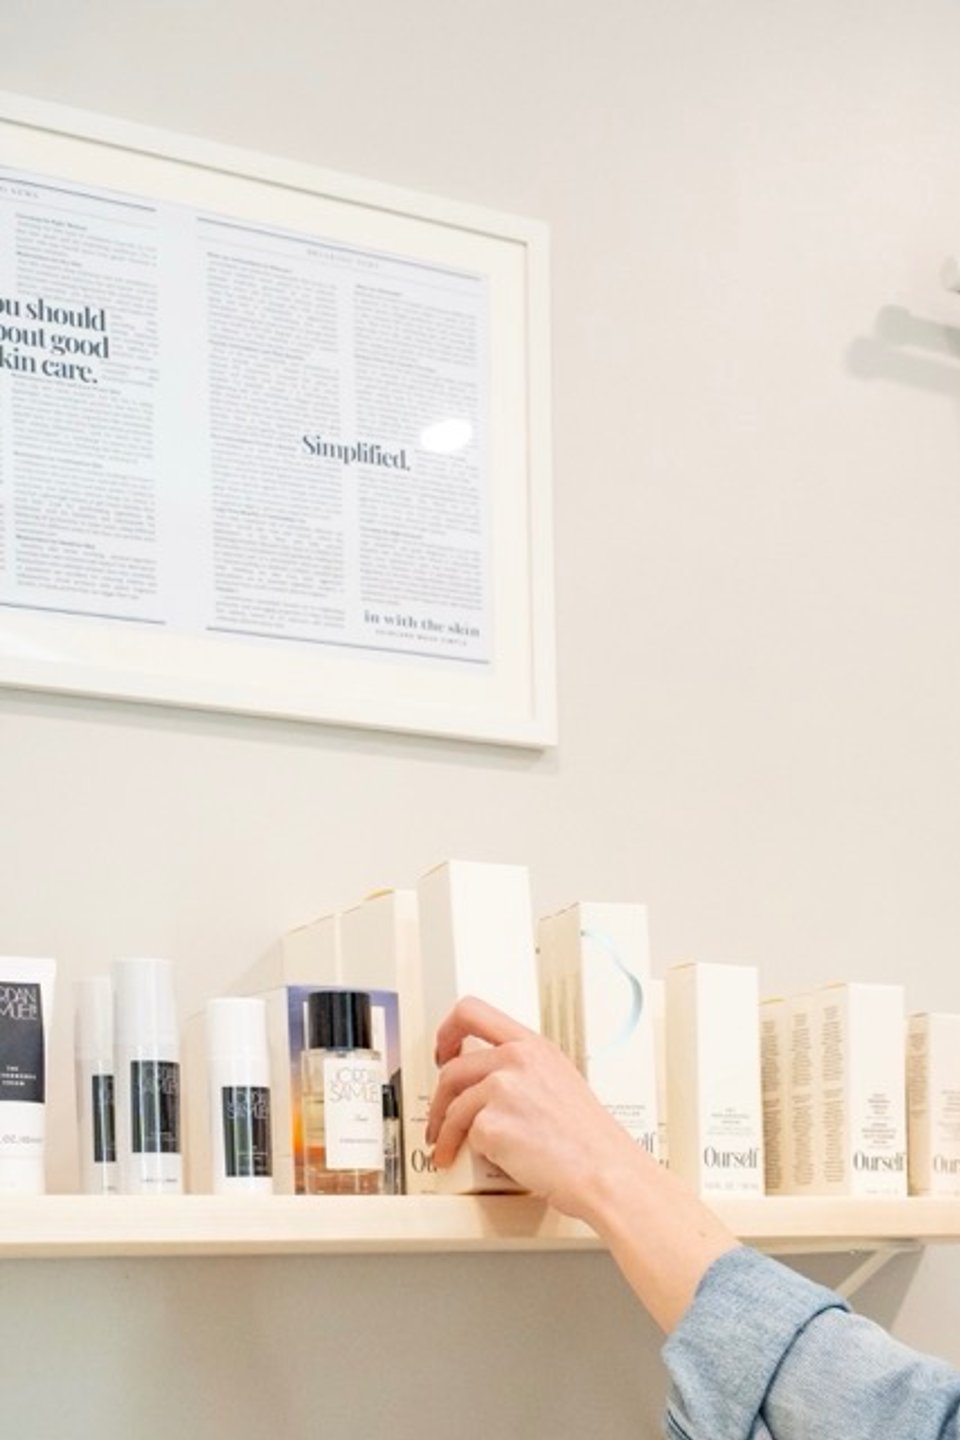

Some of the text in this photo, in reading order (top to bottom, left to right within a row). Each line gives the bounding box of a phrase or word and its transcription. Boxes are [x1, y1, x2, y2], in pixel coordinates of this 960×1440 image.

[26, 298, 106, 332] should
[50, 332, 109, 359] good
[41, 357, 98, 384] care.
[302, 433, 411, 471] Simplified.
[704, 1145, 760, 1168] Ourself
[853, 1150, 905, 1172] Ourself
